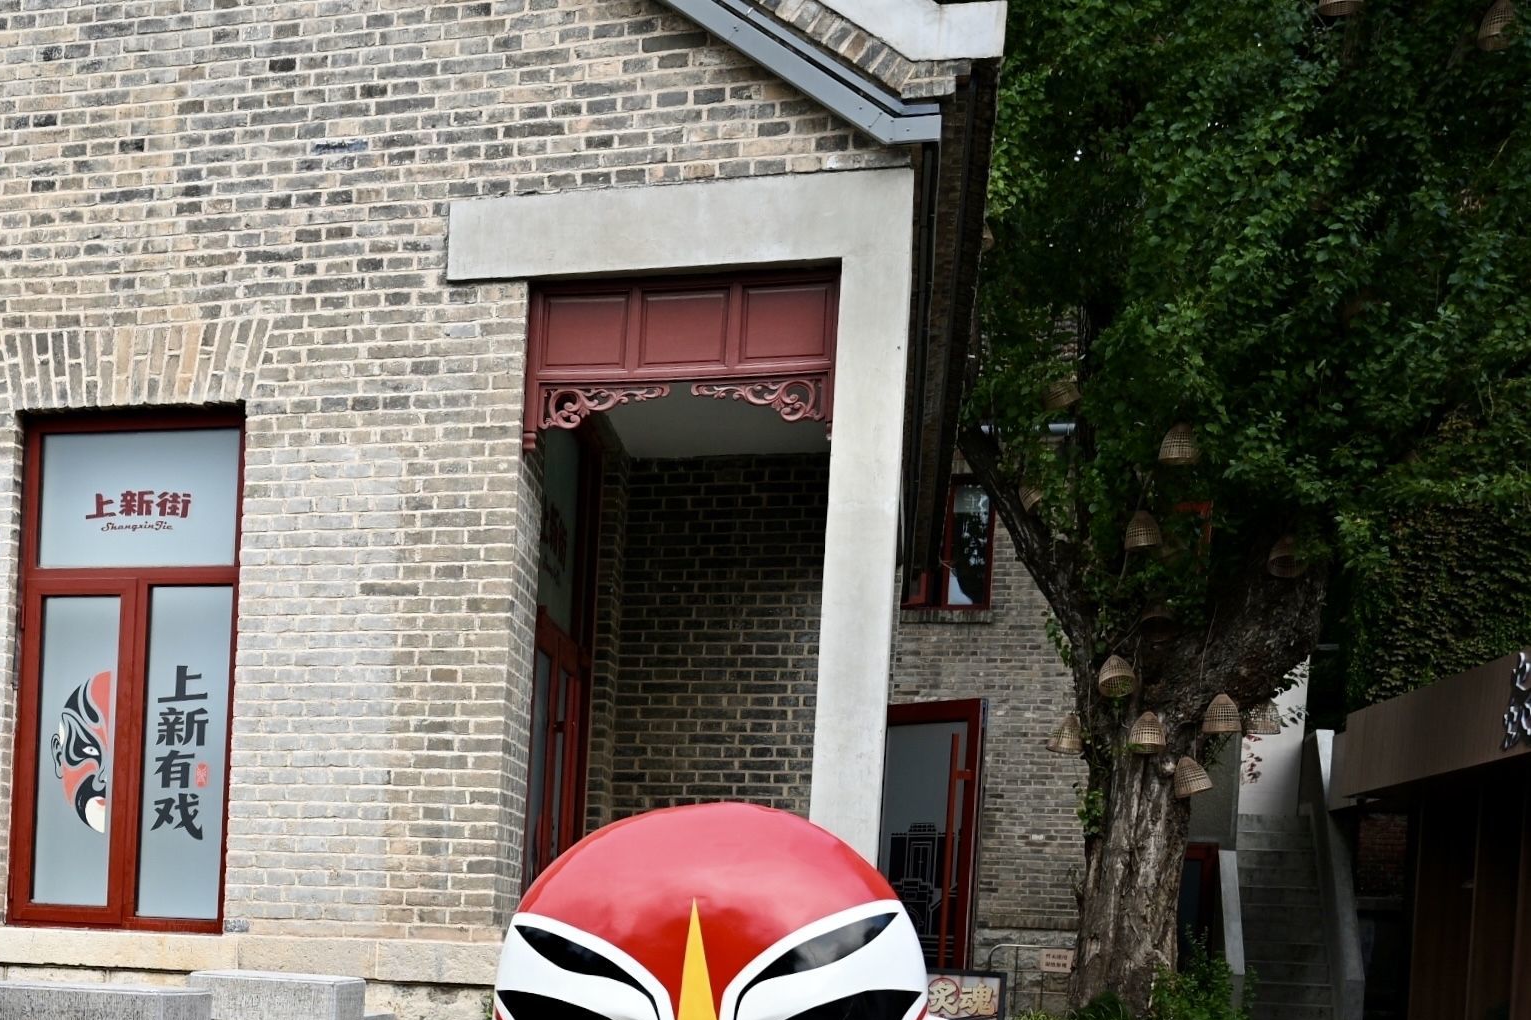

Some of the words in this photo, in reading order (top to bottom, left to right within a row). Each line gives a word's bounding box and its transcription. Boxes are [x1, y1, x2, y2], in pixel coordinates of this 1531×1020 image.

[85, 490, 192, 520] 上新街
[150, 665, 209, 841] 上新有戏
[929, 981, 995, 1016] 炙魂
